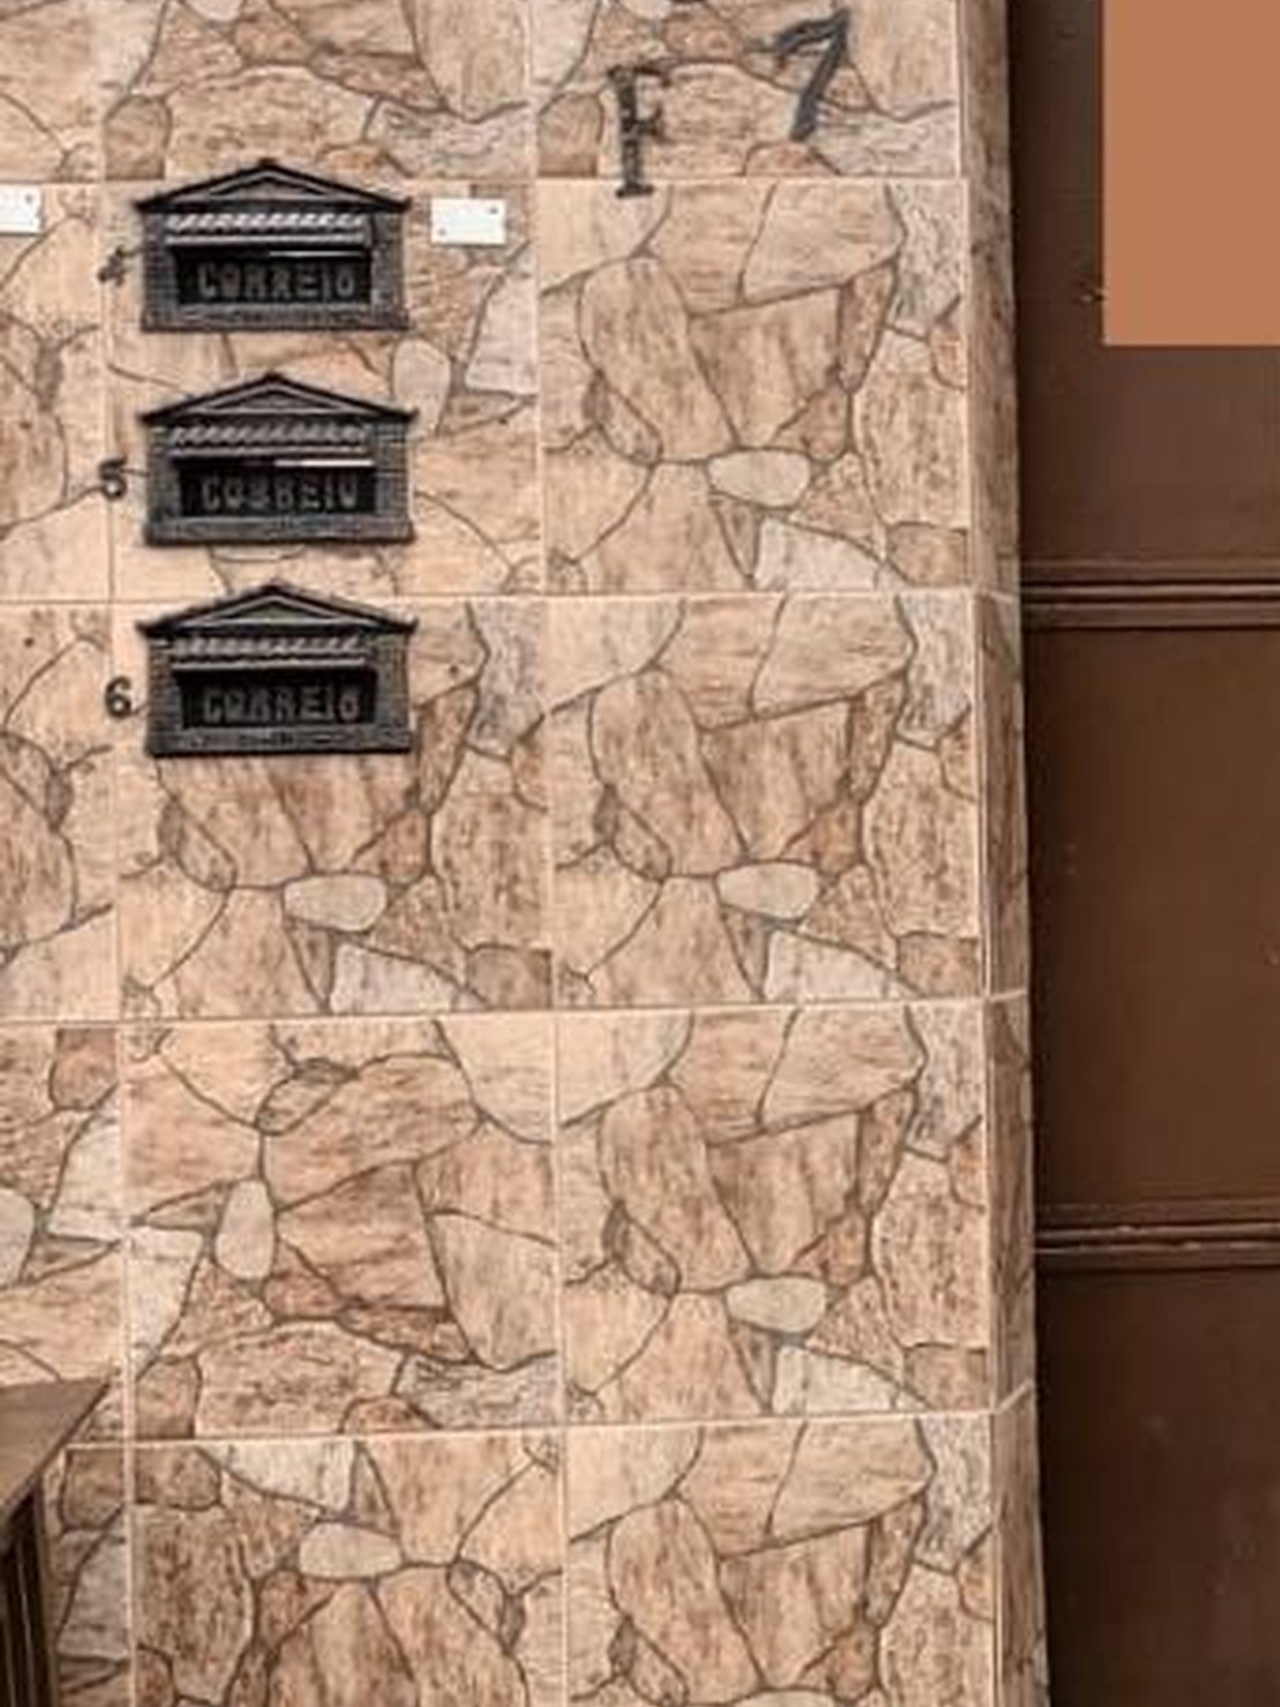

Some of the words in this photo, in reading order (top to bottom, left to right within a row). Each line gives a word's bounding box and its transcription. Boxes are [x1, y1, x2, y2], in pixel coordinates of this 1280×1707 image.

[200, 262, 356, 300] CORREIO
[97, 454, 127, 500] 5
[201, 473, 359, 510] CORREIO
[105, 676, 132, 720] 6
[203, 683, 361, 722] CORREIO
